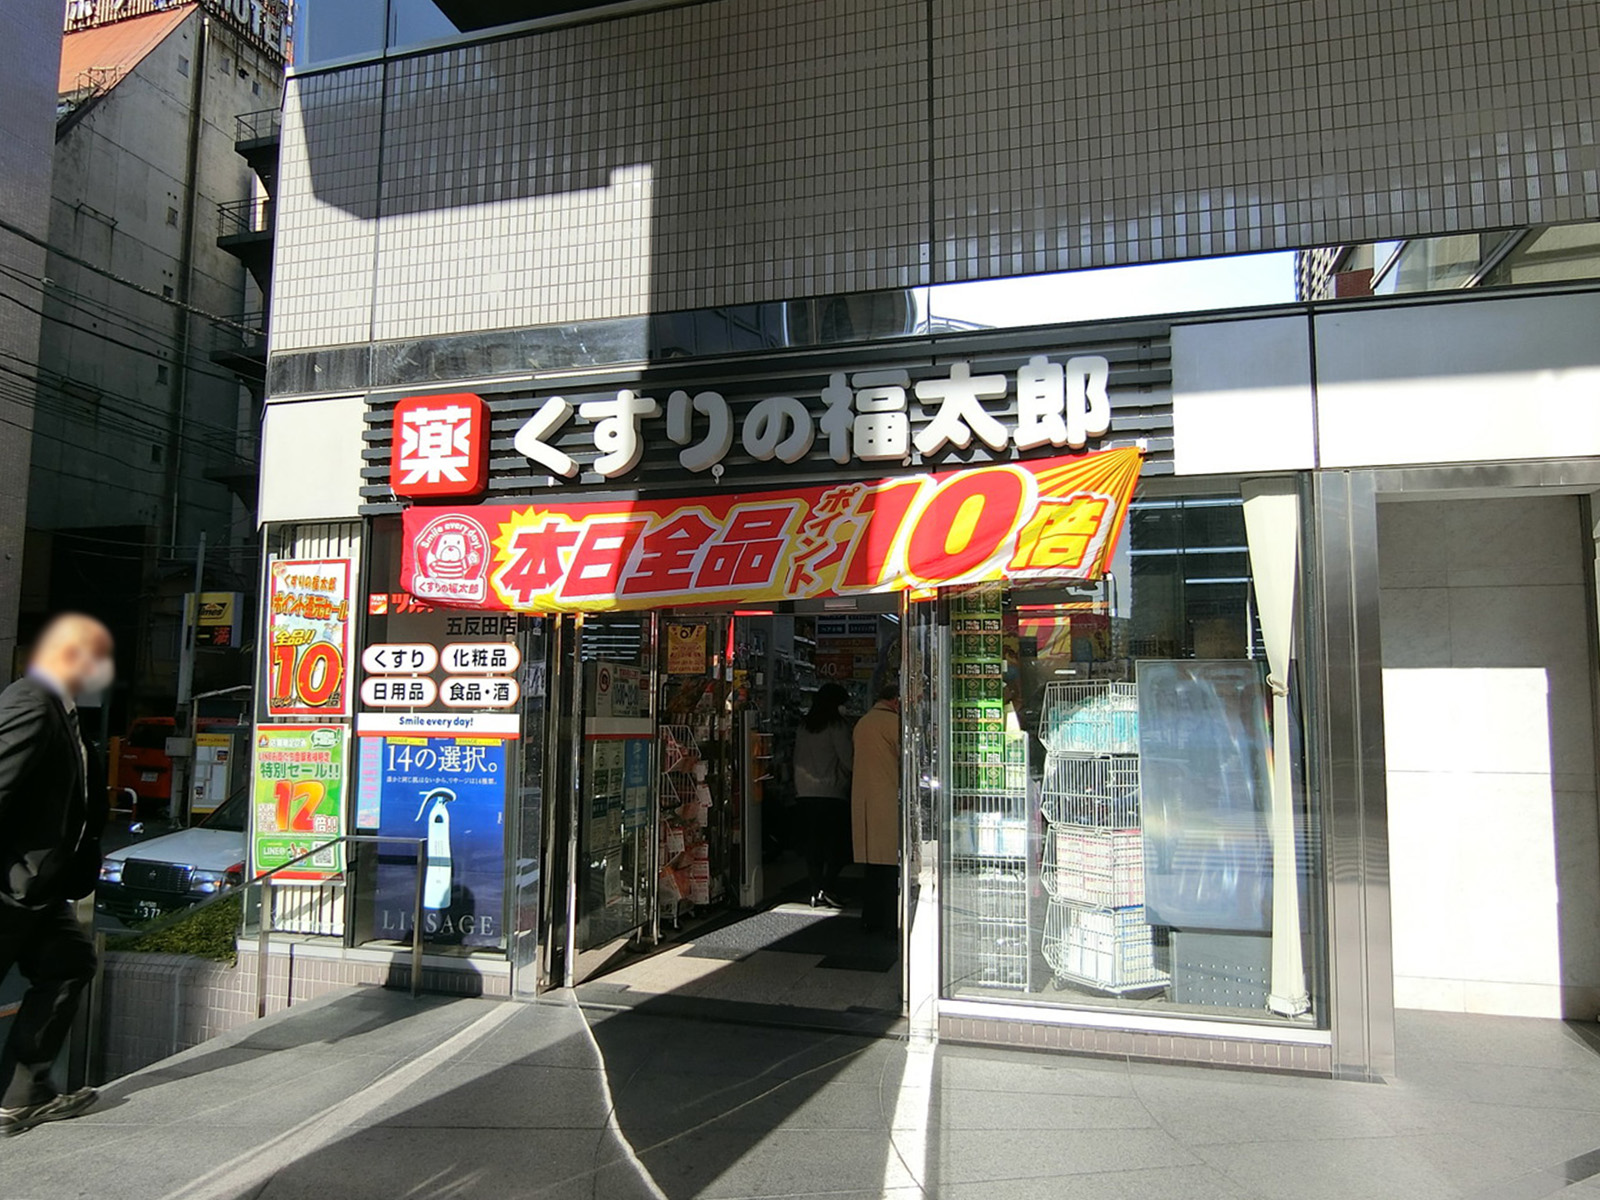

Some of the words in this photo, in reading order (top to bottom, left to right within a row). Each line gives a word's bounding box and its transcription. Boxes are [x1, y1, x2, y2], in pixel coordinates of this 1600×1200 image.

[514, 355, 1110, 478] くすりの福太郎
[401, 405, 472, 485] 薬
[421, 526, 444, 549] Smile
[444, 522, 469, 534] every
[467, 528, 483, 549] day!
[500, 506, 800, 603] 本日全品
[788, 486, 861, 595] ポイント
[418, 581, 479, 594] くすりの福太郎
[446, 616, 517, 636] 五反田店
[374, 650, 425, 668] くすり
[453, 649, 507, 667] 化粧品
[274, 641, 344, 706] 10
[373, 683, 424, 701] 日用品
[449, 682, 510, 701] 食品・酒
[399, 717, 425, 726] Smile
[426, 718, 451, 728] every
[453, 716, 474, 728] day!
[386, 745, 498, 773] 14の選択。
[274, 779, 326, 832] 12
